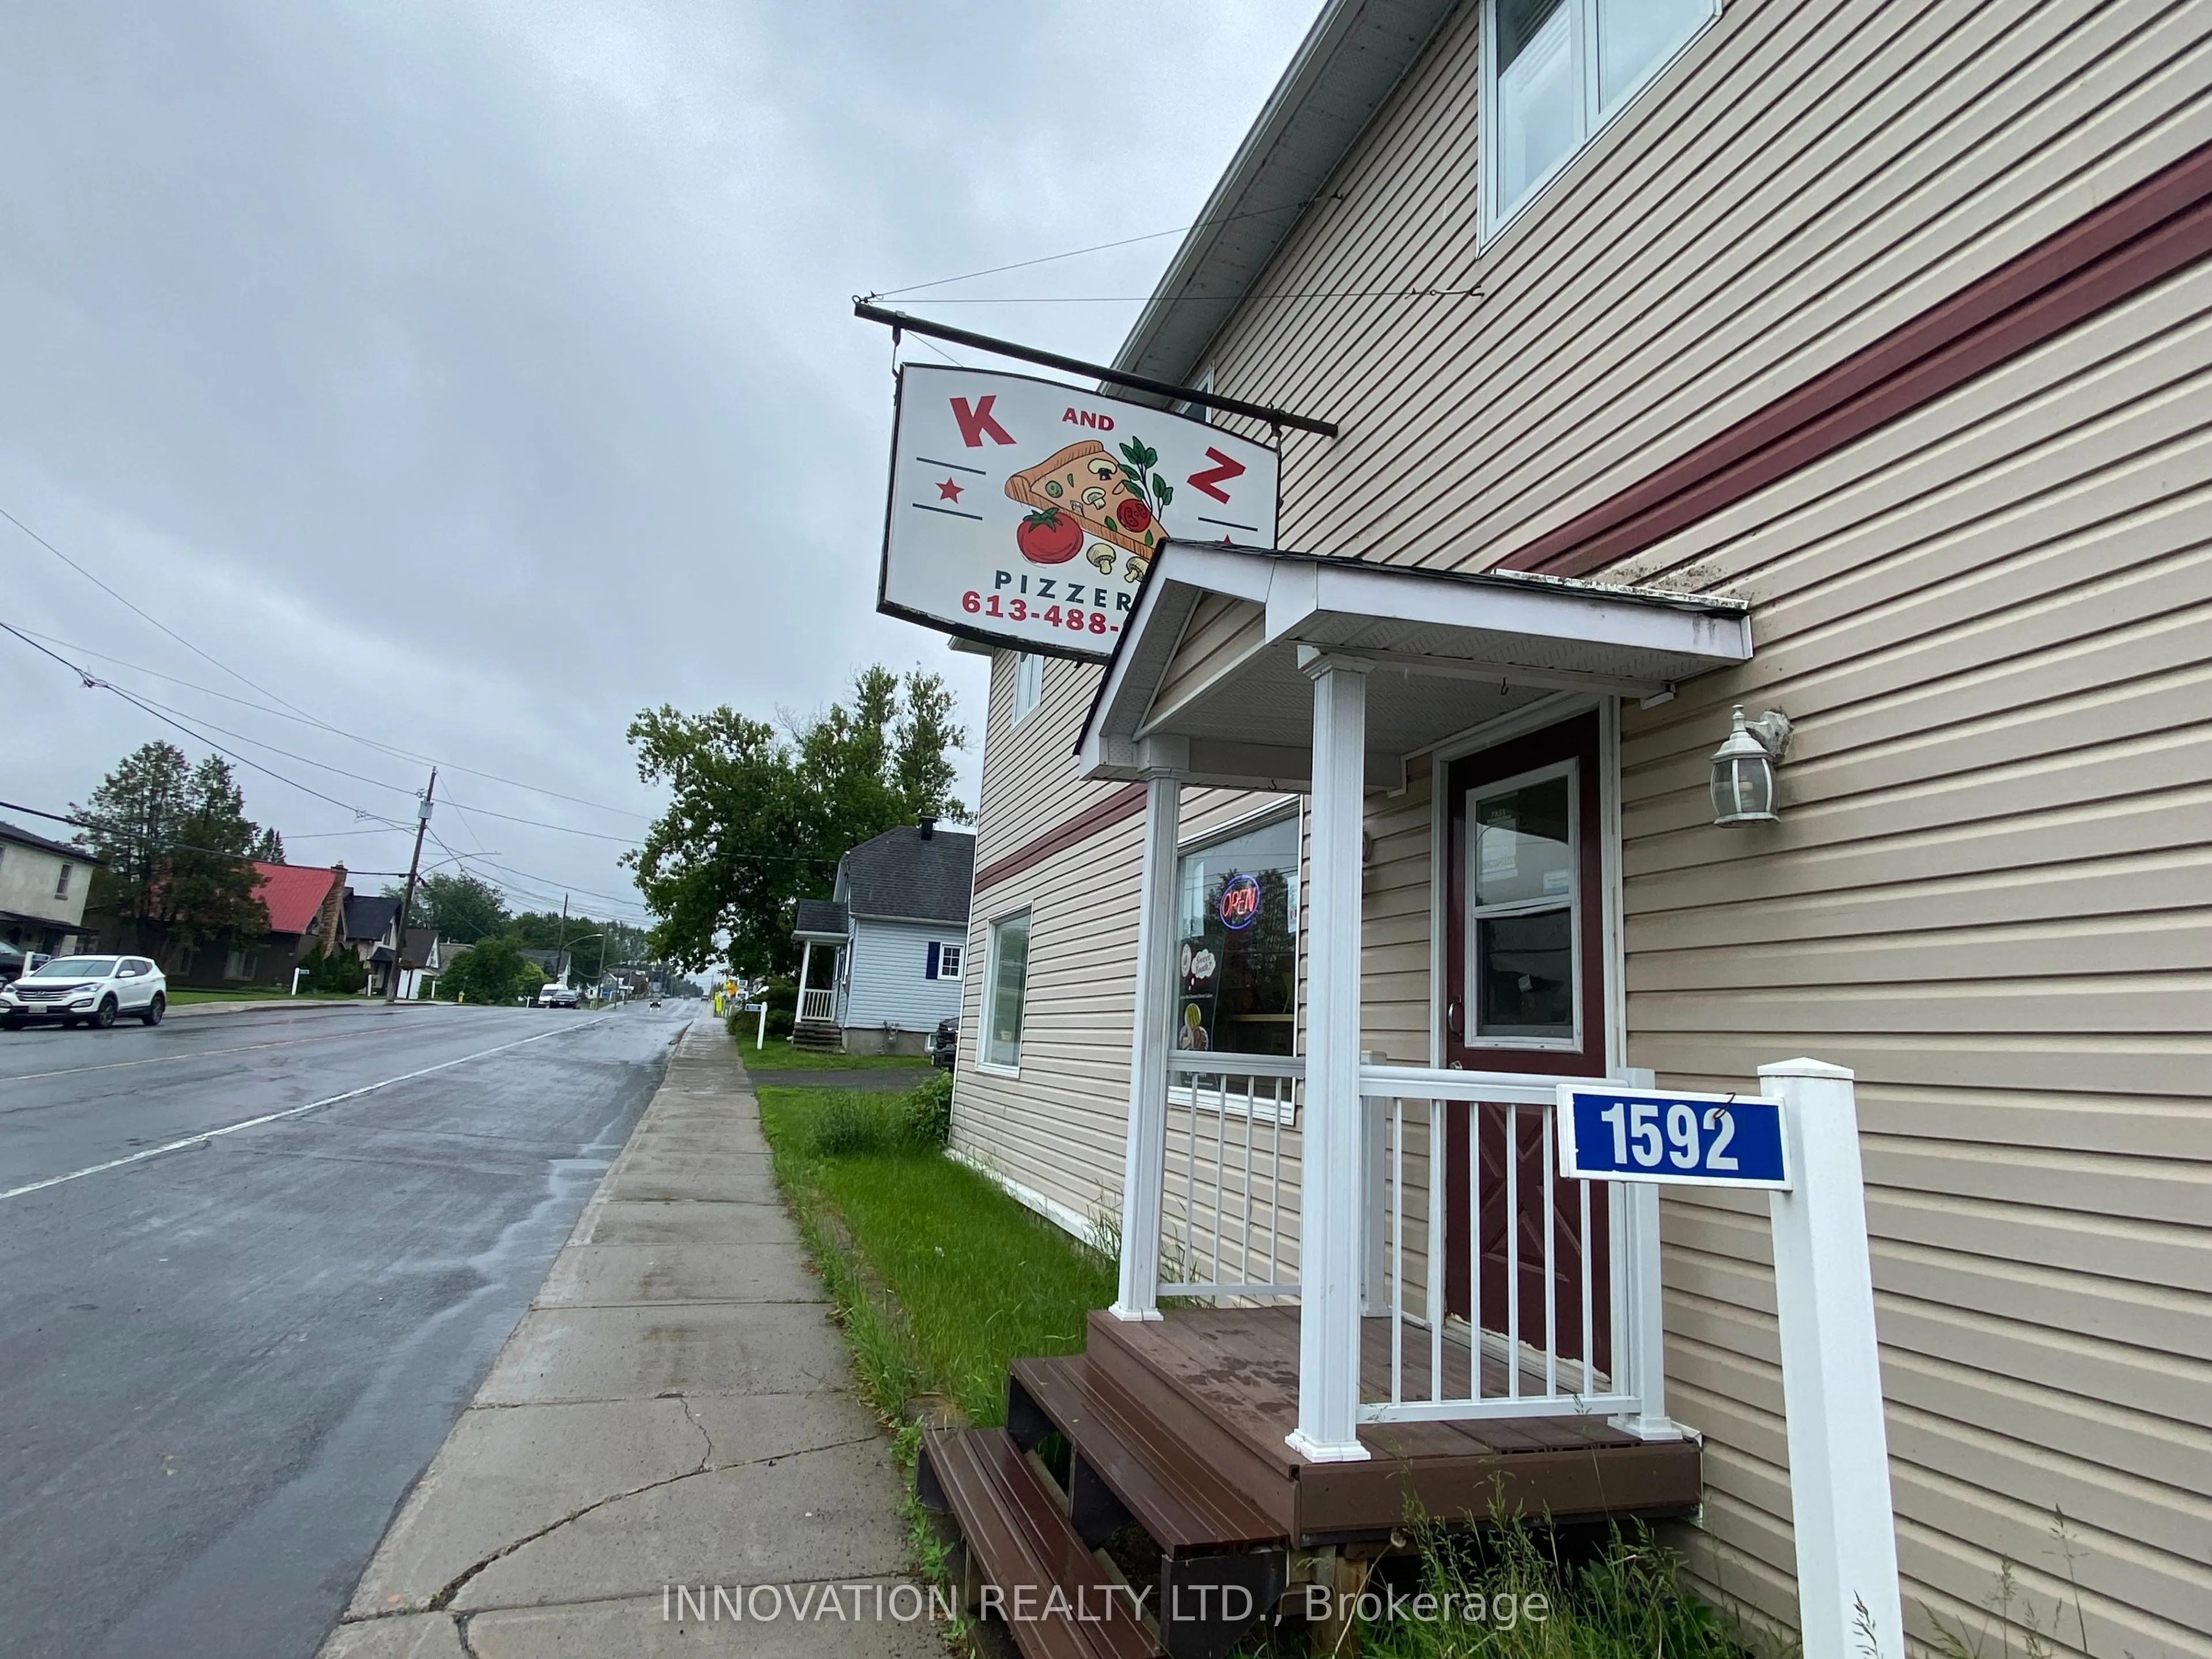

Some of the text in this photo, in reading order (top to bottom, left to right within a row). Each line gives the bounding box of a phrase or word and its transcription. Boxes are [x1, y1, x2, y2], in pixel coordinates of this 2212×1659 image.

[949, 395, 1246, 505] K AND Z
[1222, 887, 1256, 918] OPEN
[1601, 1103, 1739, 1171] 1592
